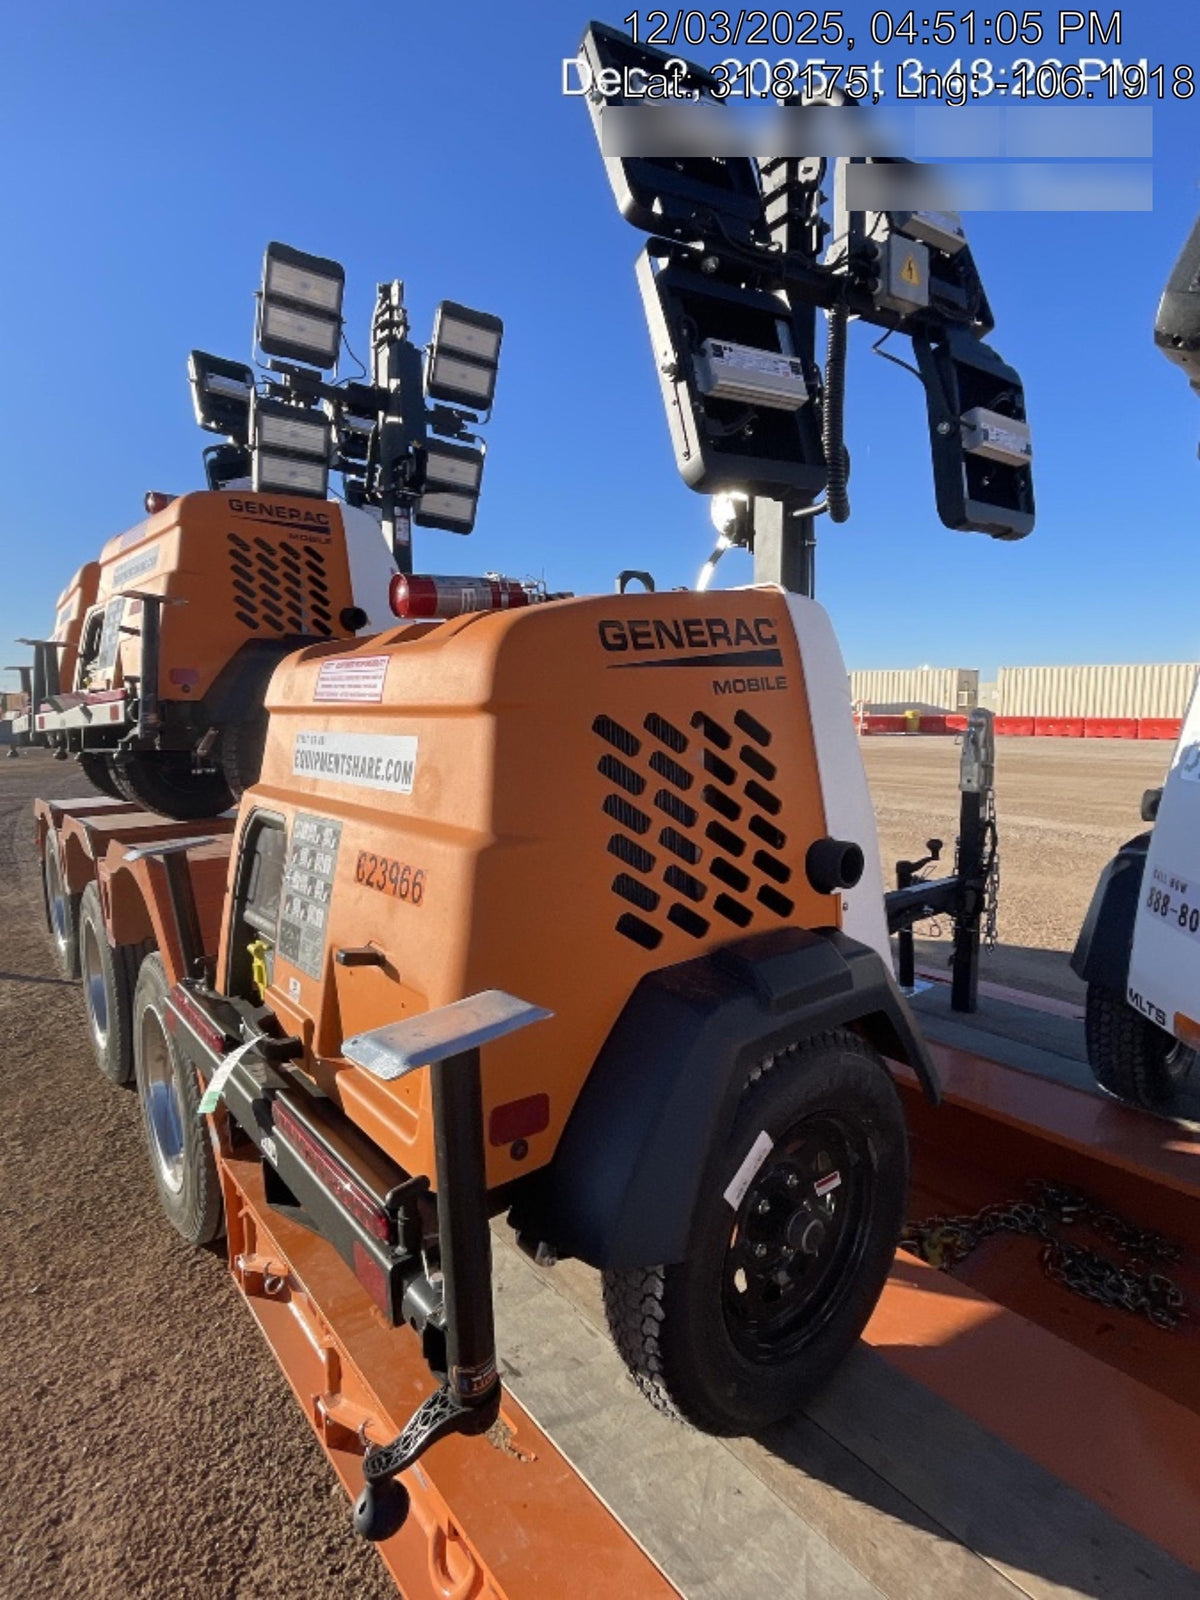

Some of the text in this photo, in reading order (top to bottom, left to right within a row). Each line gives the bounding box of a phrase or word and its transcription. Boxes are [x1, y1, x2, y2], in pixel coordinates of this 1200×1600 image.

[228, 498, 330, 526] GENERAC
[598, 617, 778, 651] GENERAC
[711, 675, 788, 696] MOBILE
[294, 748, 414, 786] EQUIPMENTSHARE.COM
[356, 851, 424, 905] 623966
[1128, 987, 1167, 1027] MLTS
